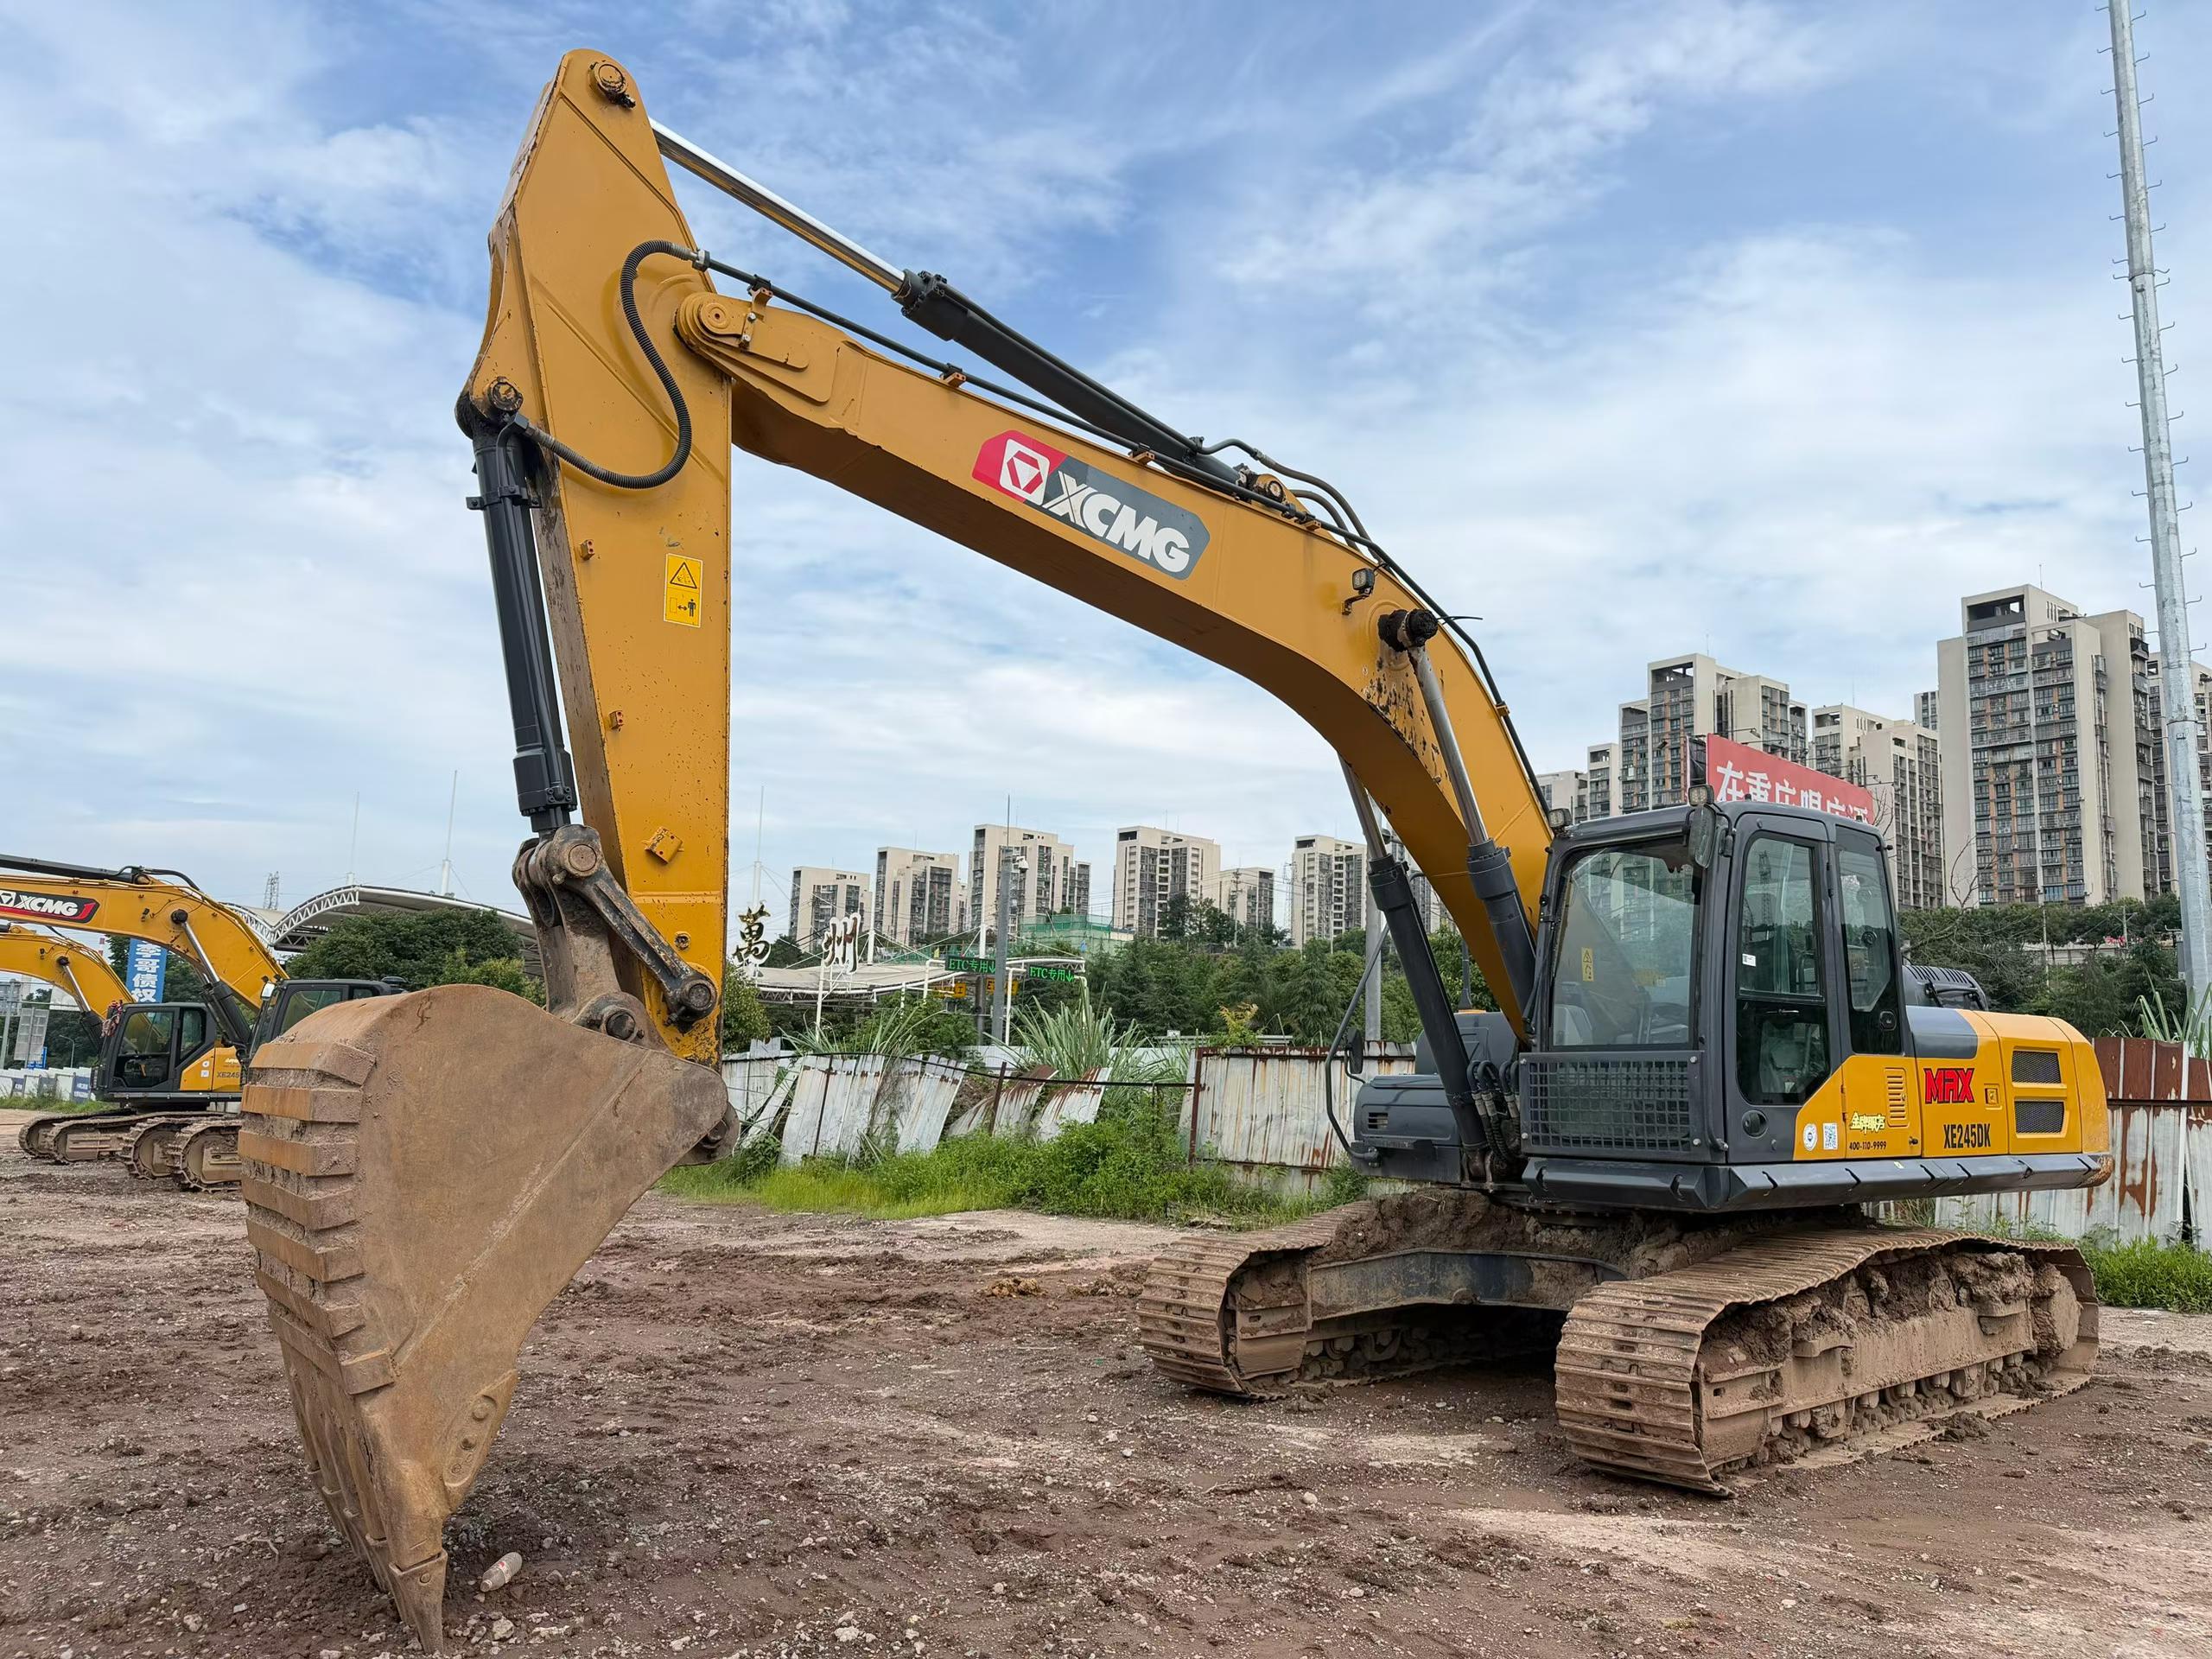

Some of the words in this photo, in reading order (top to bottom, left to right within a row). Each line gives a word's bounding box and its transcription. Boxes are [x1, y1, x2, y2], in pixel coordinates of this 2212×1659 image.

[1042, 470, 1190, 573] XCMG
[13, 894, 79, 917] XCMG
[948, 958, 988, 973] ETC专用
[1029, 966, 1065, 982] ETC专用
[1923, 1068, 1974, 1104] MAX
[1849, 1141, 1887, 1150] 400-110-9999
[1943, 1123, 1991, 1148] XE245DK
